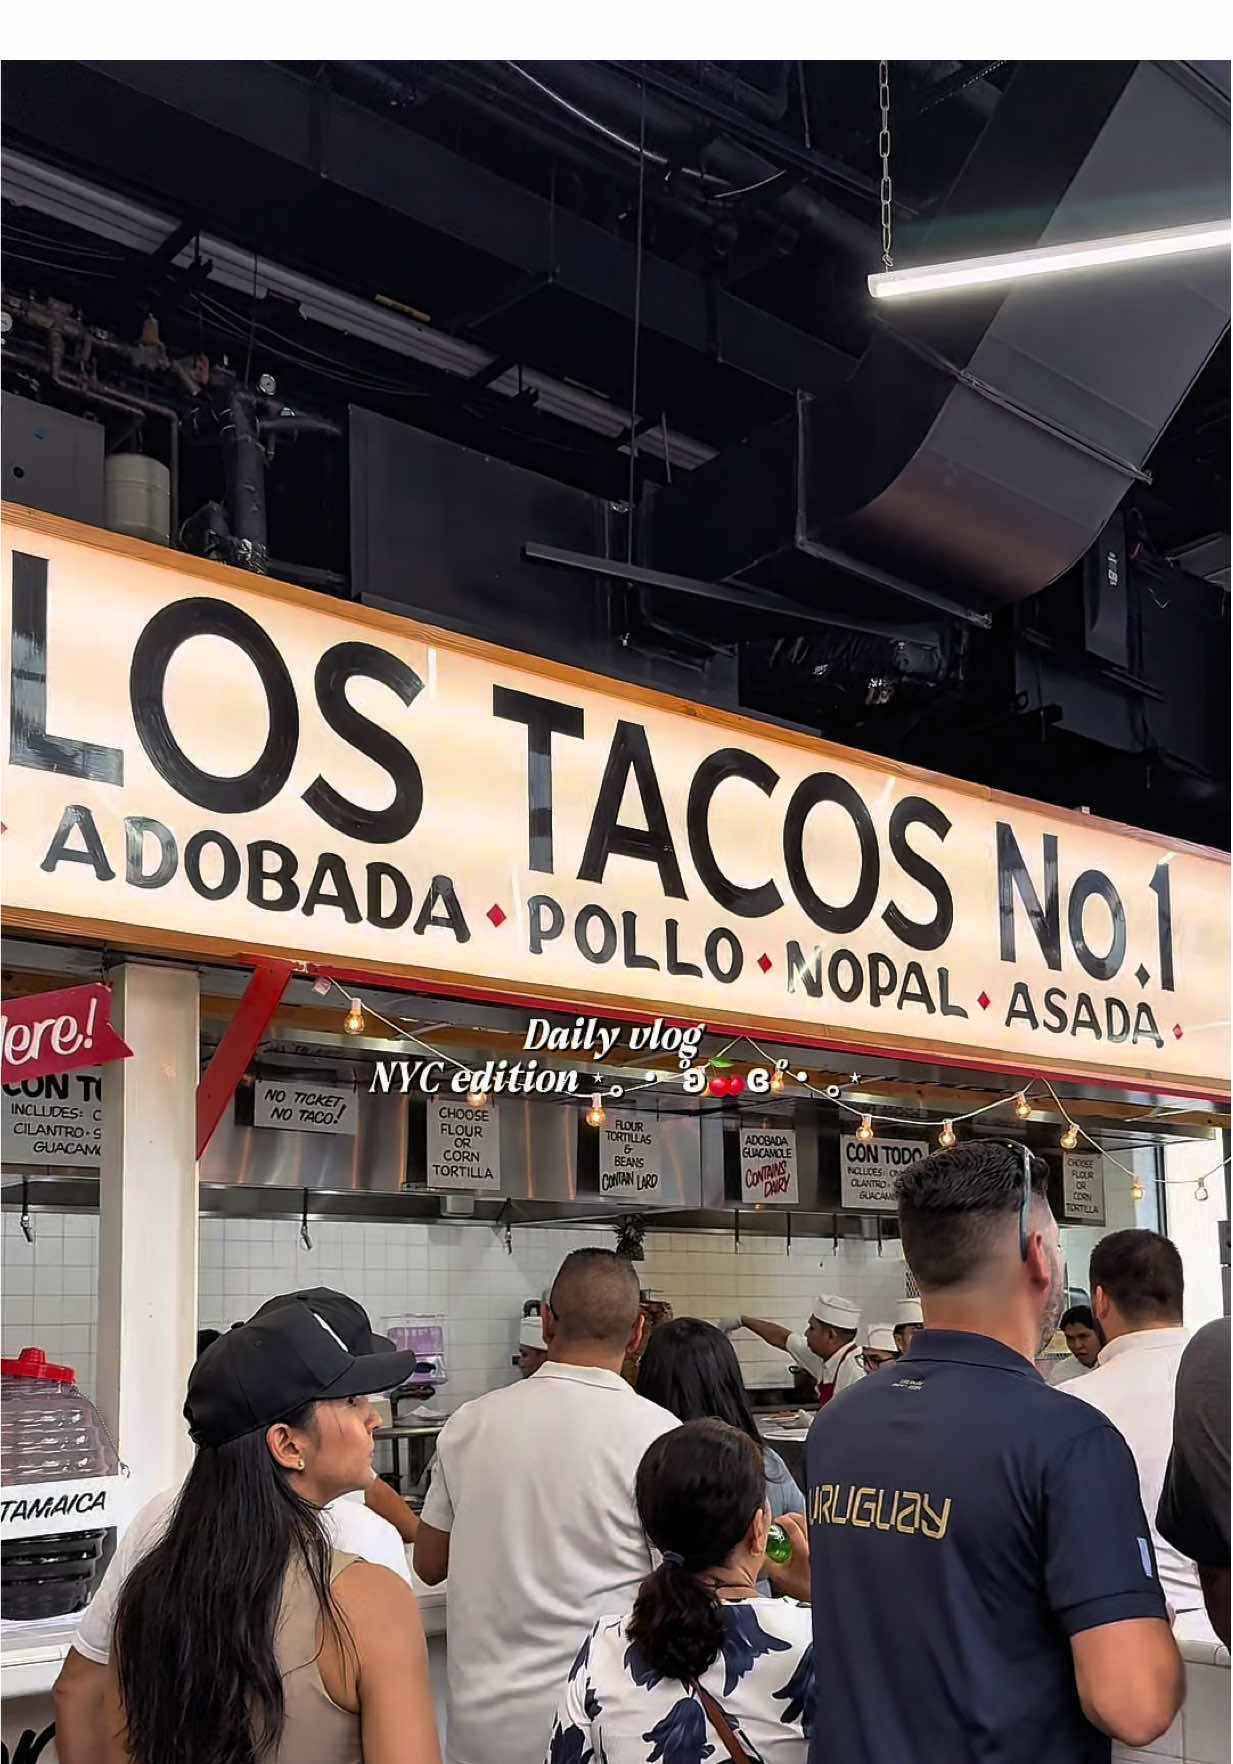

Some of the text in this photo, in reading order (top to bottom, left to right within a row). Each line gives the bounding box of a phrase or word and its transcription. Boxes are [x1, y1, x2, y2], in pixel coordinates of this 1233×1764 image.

[10, 550, 425, 845] LOS
[492, 683, 954, 952] TACOS
[40, 804, 1165, 1049] ADOBADA POLLO NOPAL ASADA
[264, 1089, 344, 1107] NO TICKET
[11, 1103, 84, 1119] INCLUDES:
[270, 1104, 347, 1125] NO TACO!
[439, 1106, 489, 1122] CHOOSE
[440, 1123, 483, 1138] FLOUR
[615, 1119, 644, 1132] FLOUR
[454, 1138, 472, 1149] OR
[605, 1130, 652, 1145] TORTILLAS
[745, 1135, 789, 1147] ADOBADA
[443, 1150, 480, 1162] CORN
[623, 1144, 634, 1155] &
[742, 1147, 792, 1159] GUACAMOLE
[846, 1142, 879, 1164] CON
[614, 1155, 645, 1168] BEANS
[432, 1164, 494, 1179] TORTILLA
[745, 1160, 787, 1189] CONTAINS
[601, 1171, 658, 1191] CONTAIN LARD
[764, 1174, 791, 1199] DAIRY
[1076, 1181, 1087, 1190] OR
